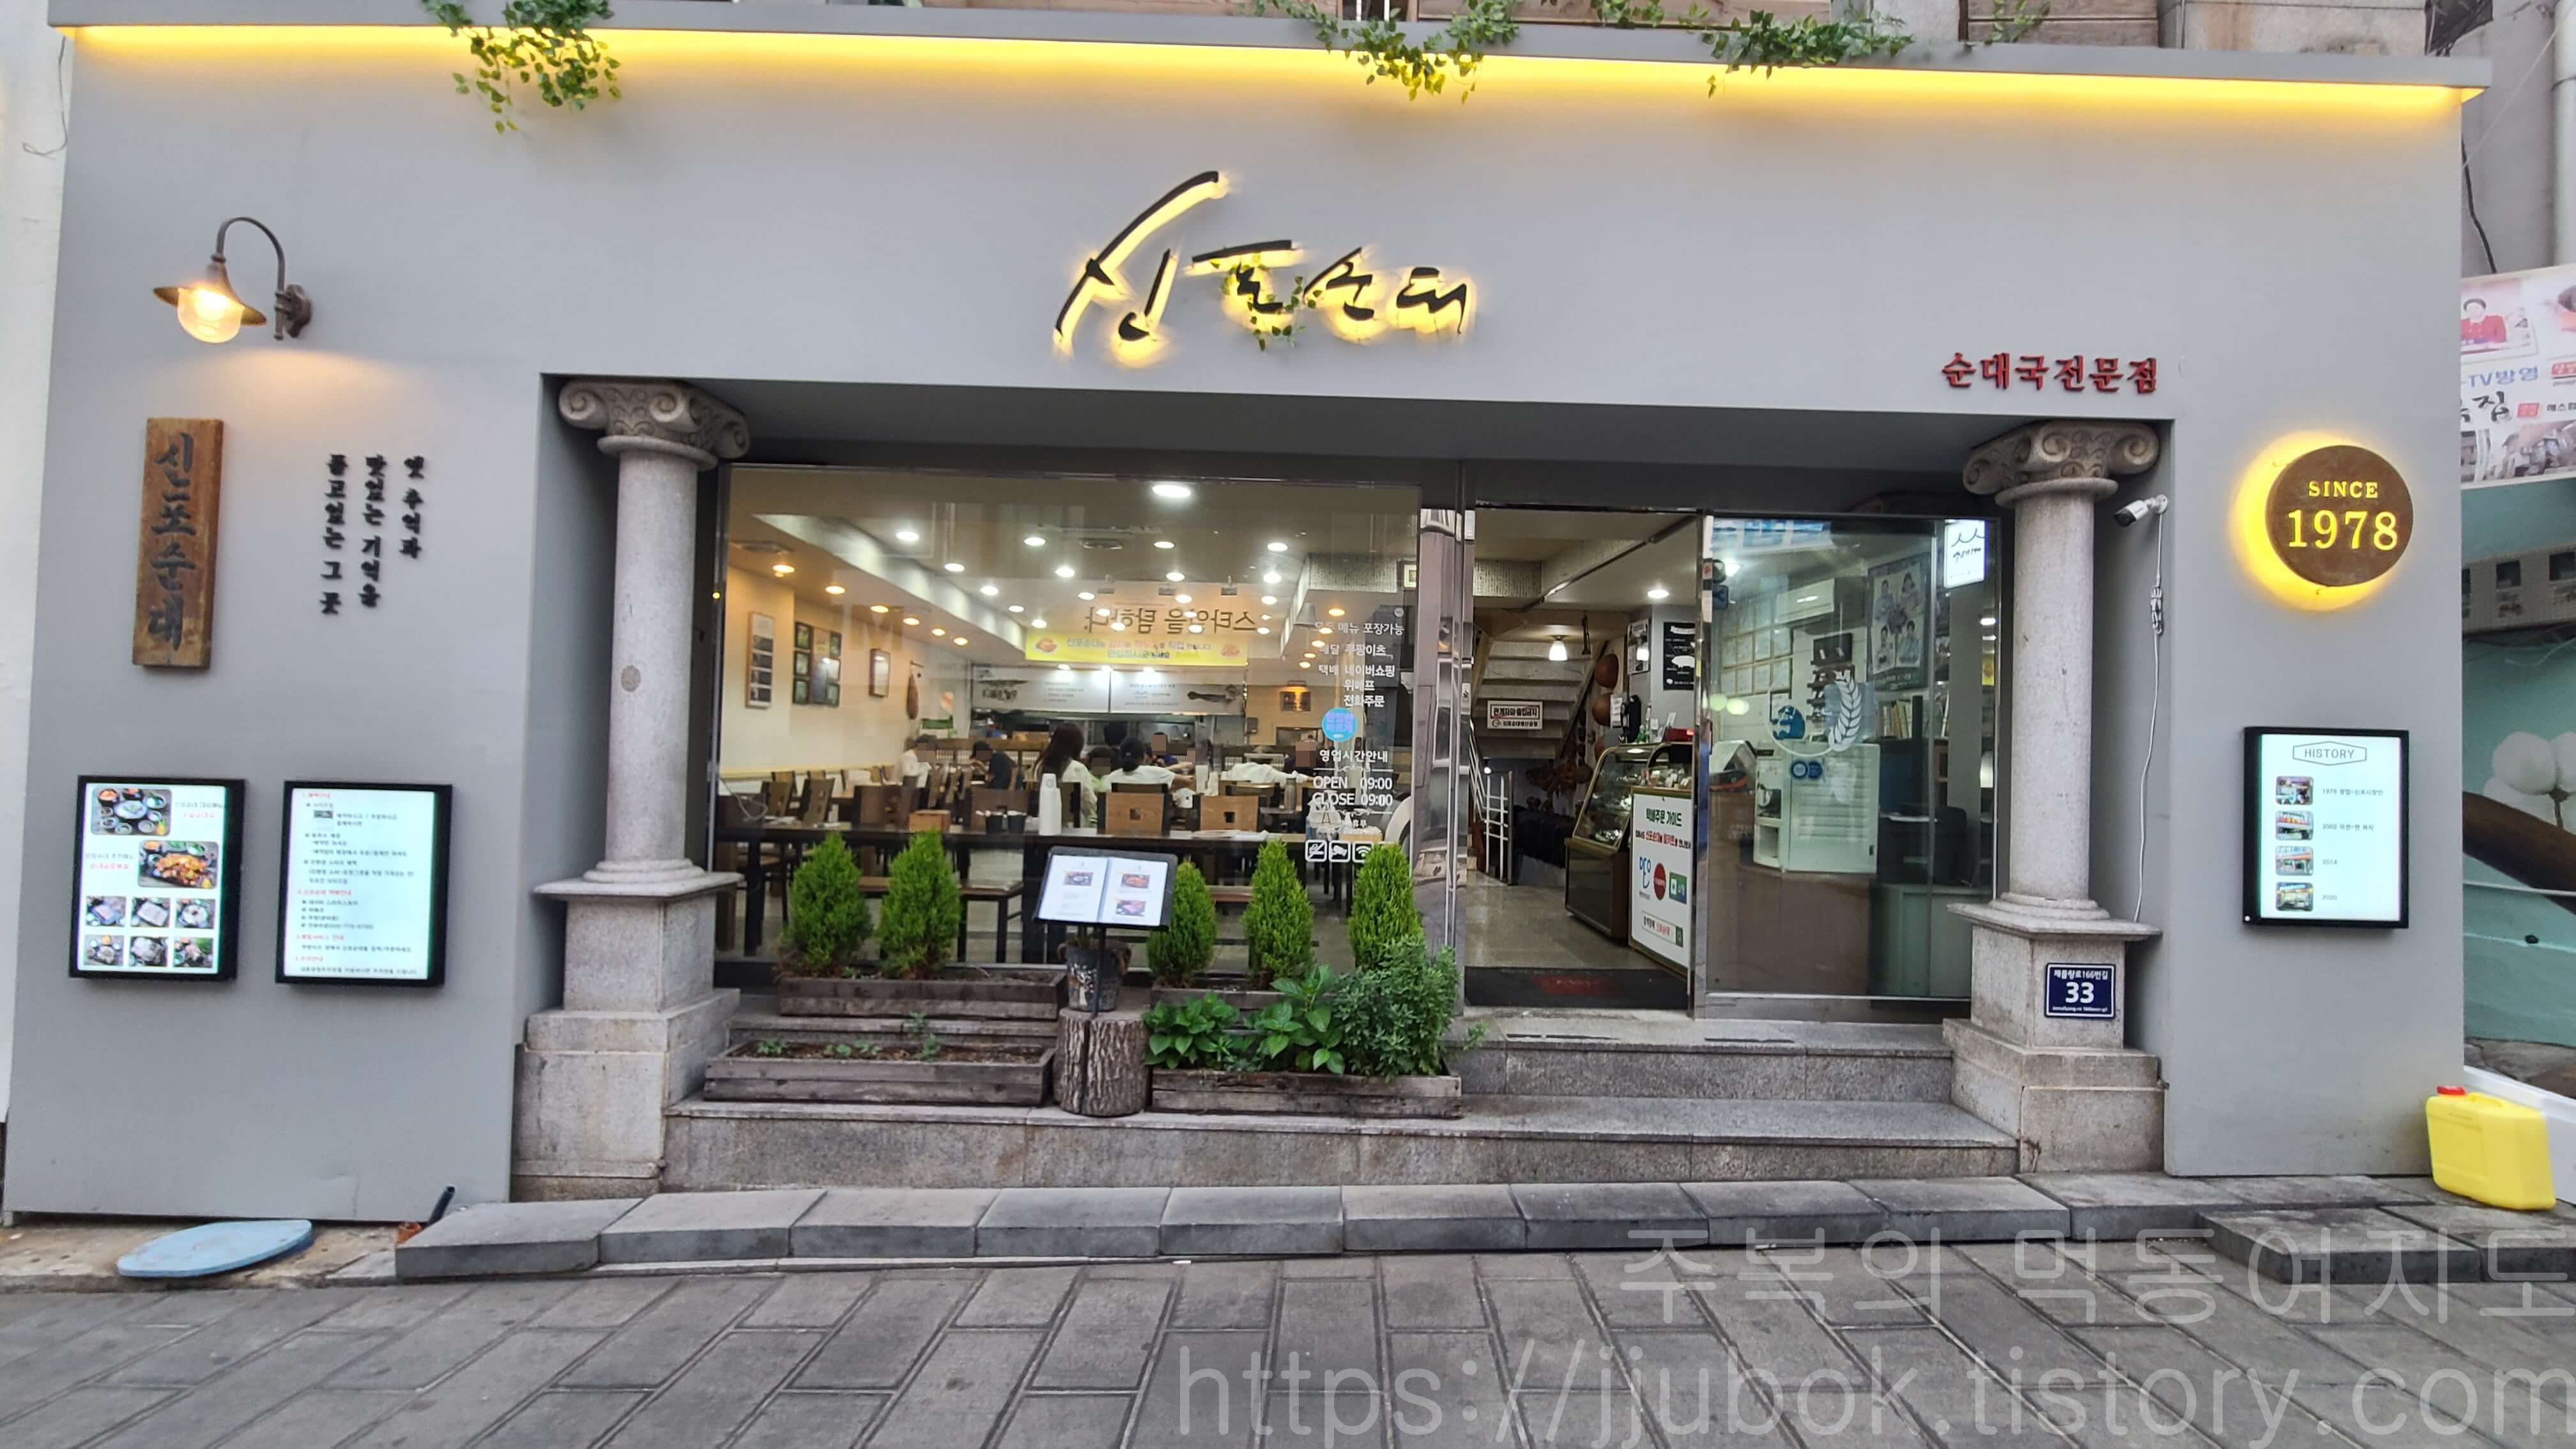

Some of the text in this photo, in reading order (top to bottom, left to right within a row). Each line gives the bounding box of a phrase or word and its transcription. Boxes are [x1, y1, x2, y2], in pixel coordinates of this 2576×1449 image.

[1941, 352, 2158, 394] 순대국전문점
[2469, 367, 2538, 387] TV방영
[2308, 480, 2379, 499] SINCE
[358, 453, 387, 609] 맛있는 기억을
[399, 487, 425, 560] 추억과
[2287, 509, 2398, 551] 1978
[146, 431, 197, 652] 신포순대
[320, 560, 343, 581] 그
[318, 590, 342, 616] 곳
[1338, 622, 1360, 634] 메뉴
[1363, 622, 1404, 636] 포장가능
[1345, 643, 1386, 656] 쿠팡이츠
[1319, 664, 1395, 678] 택배 네이버쇼핑
[1344, 679, 1376, 692] 위메프
[1344, 694, 1386, 709] 전화주문
[1319, 749, 1388, 763] 영업시간안내
[2304, 747, 2356, 759] HISTORY
[1313, 776, 1393, 790] OPEN 09:00
[1312, 792, 1393, 807] CLOSE 09:00
[1646, 808, 1682, 827] 택배주문 가이드
[2065, 981, 2094, 1003] 33
